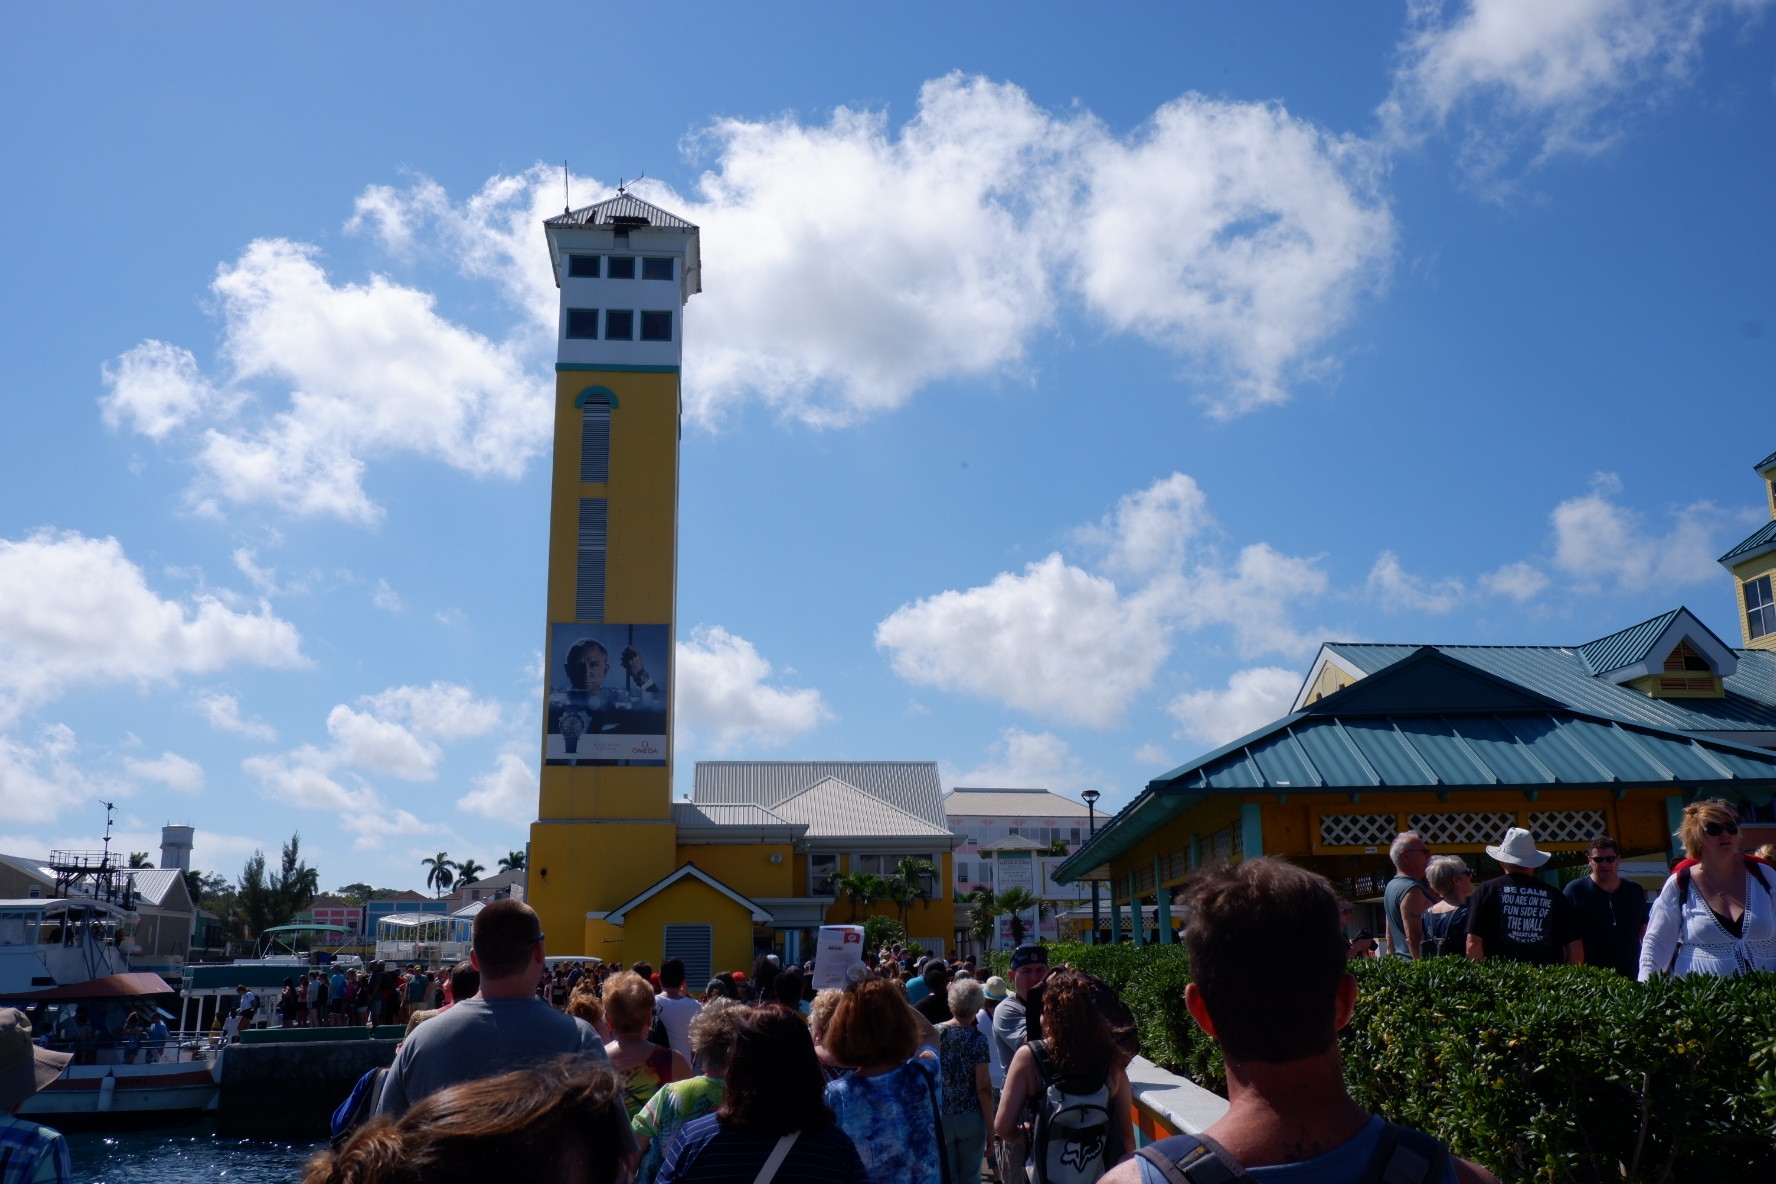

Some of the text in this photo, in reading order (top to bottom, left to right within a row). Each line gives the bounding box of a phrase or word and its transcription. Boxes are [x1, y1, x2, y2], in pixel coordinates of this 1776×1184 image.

[1520, 888, 1547, 897] CALM
[1502, 894, 1552, 908] YOU ARE ON THE
[1503, 905, 1550, 918] FUN SIDE OF
[1508, 916, 1542, 932] THE WALL
[1508, 932, 1544, 943] MEXICO
